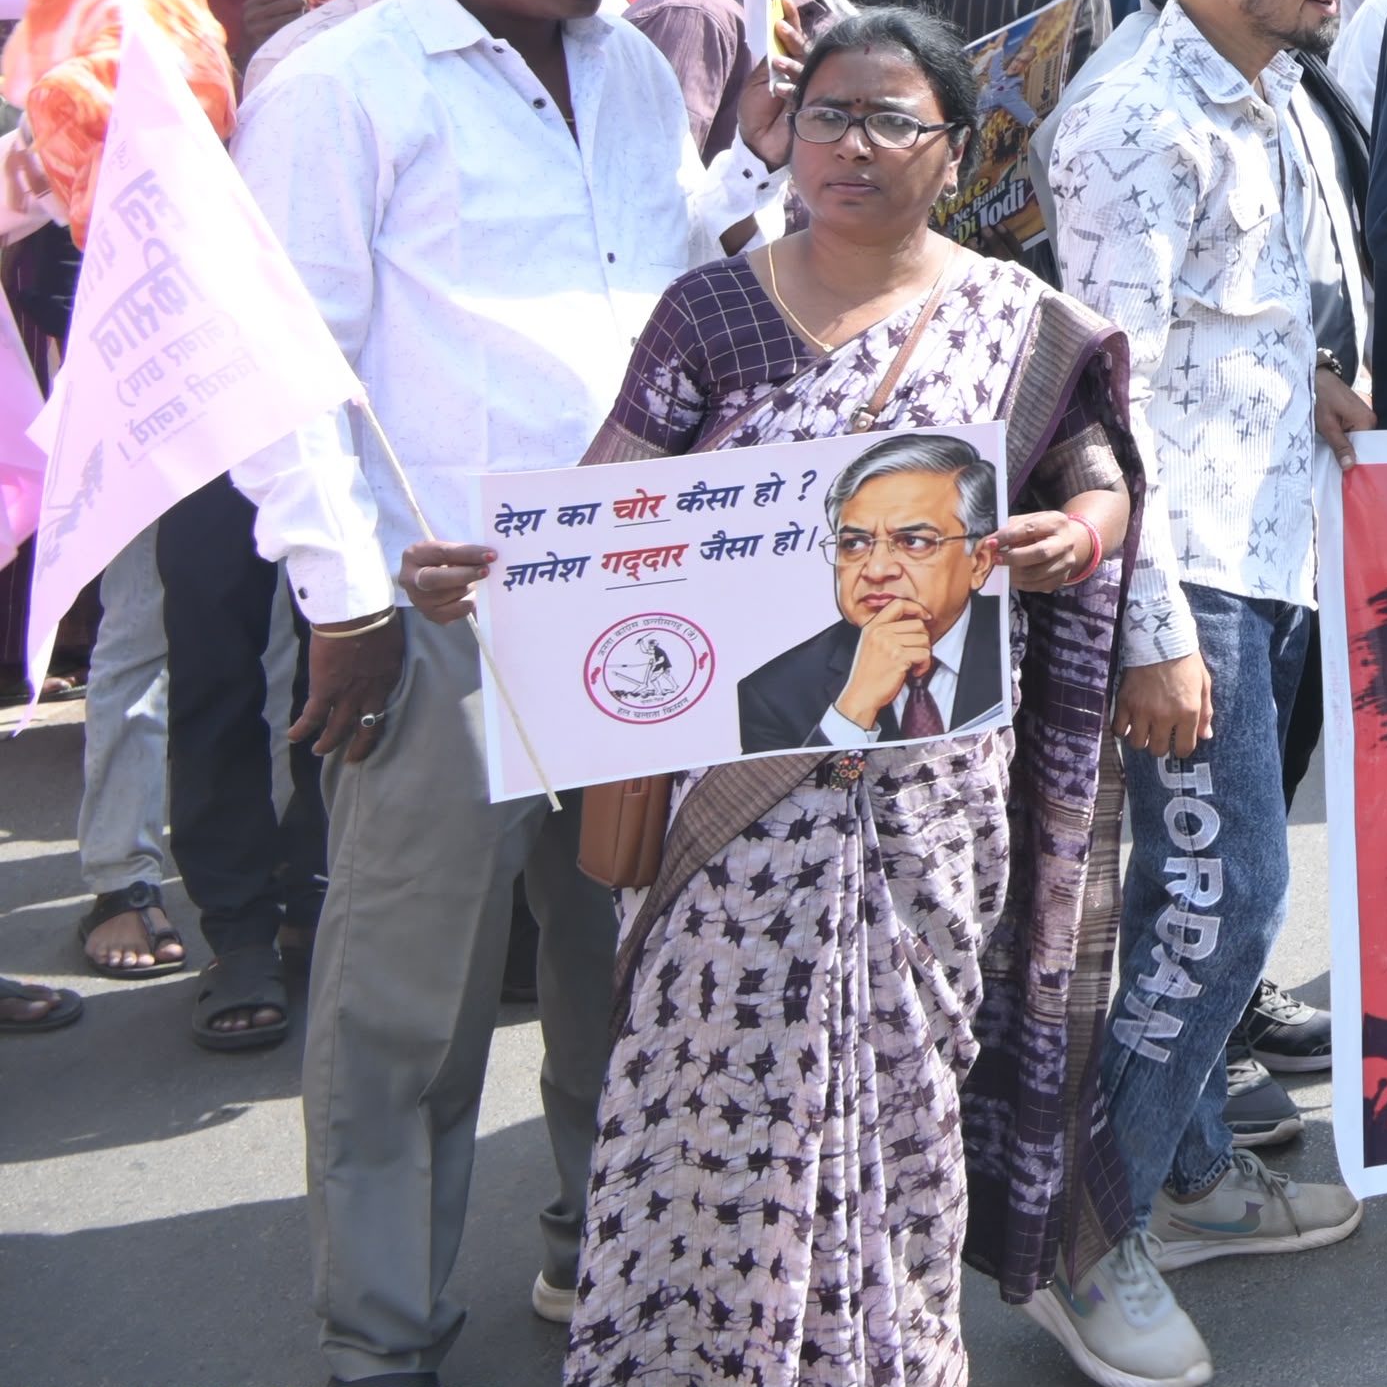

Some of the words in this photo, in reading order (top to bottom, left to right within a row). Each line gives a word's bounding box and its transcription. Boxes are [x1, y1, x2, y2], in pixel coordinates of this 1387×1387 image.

[494, 503, 547, 538] देश
[557, 502, 602, 528] का
[613, 488, 667, 520] चोर
[676, 481, 744, 514] कैसा
[753, 472, 785, 507] हो
[797, 469, 817, 502] ?
[503, 552, 591, 591] ज्ञानेश
[700, 530, 763, 563] जैसा
[1112, 745, 1224, 1064] JORDAN
